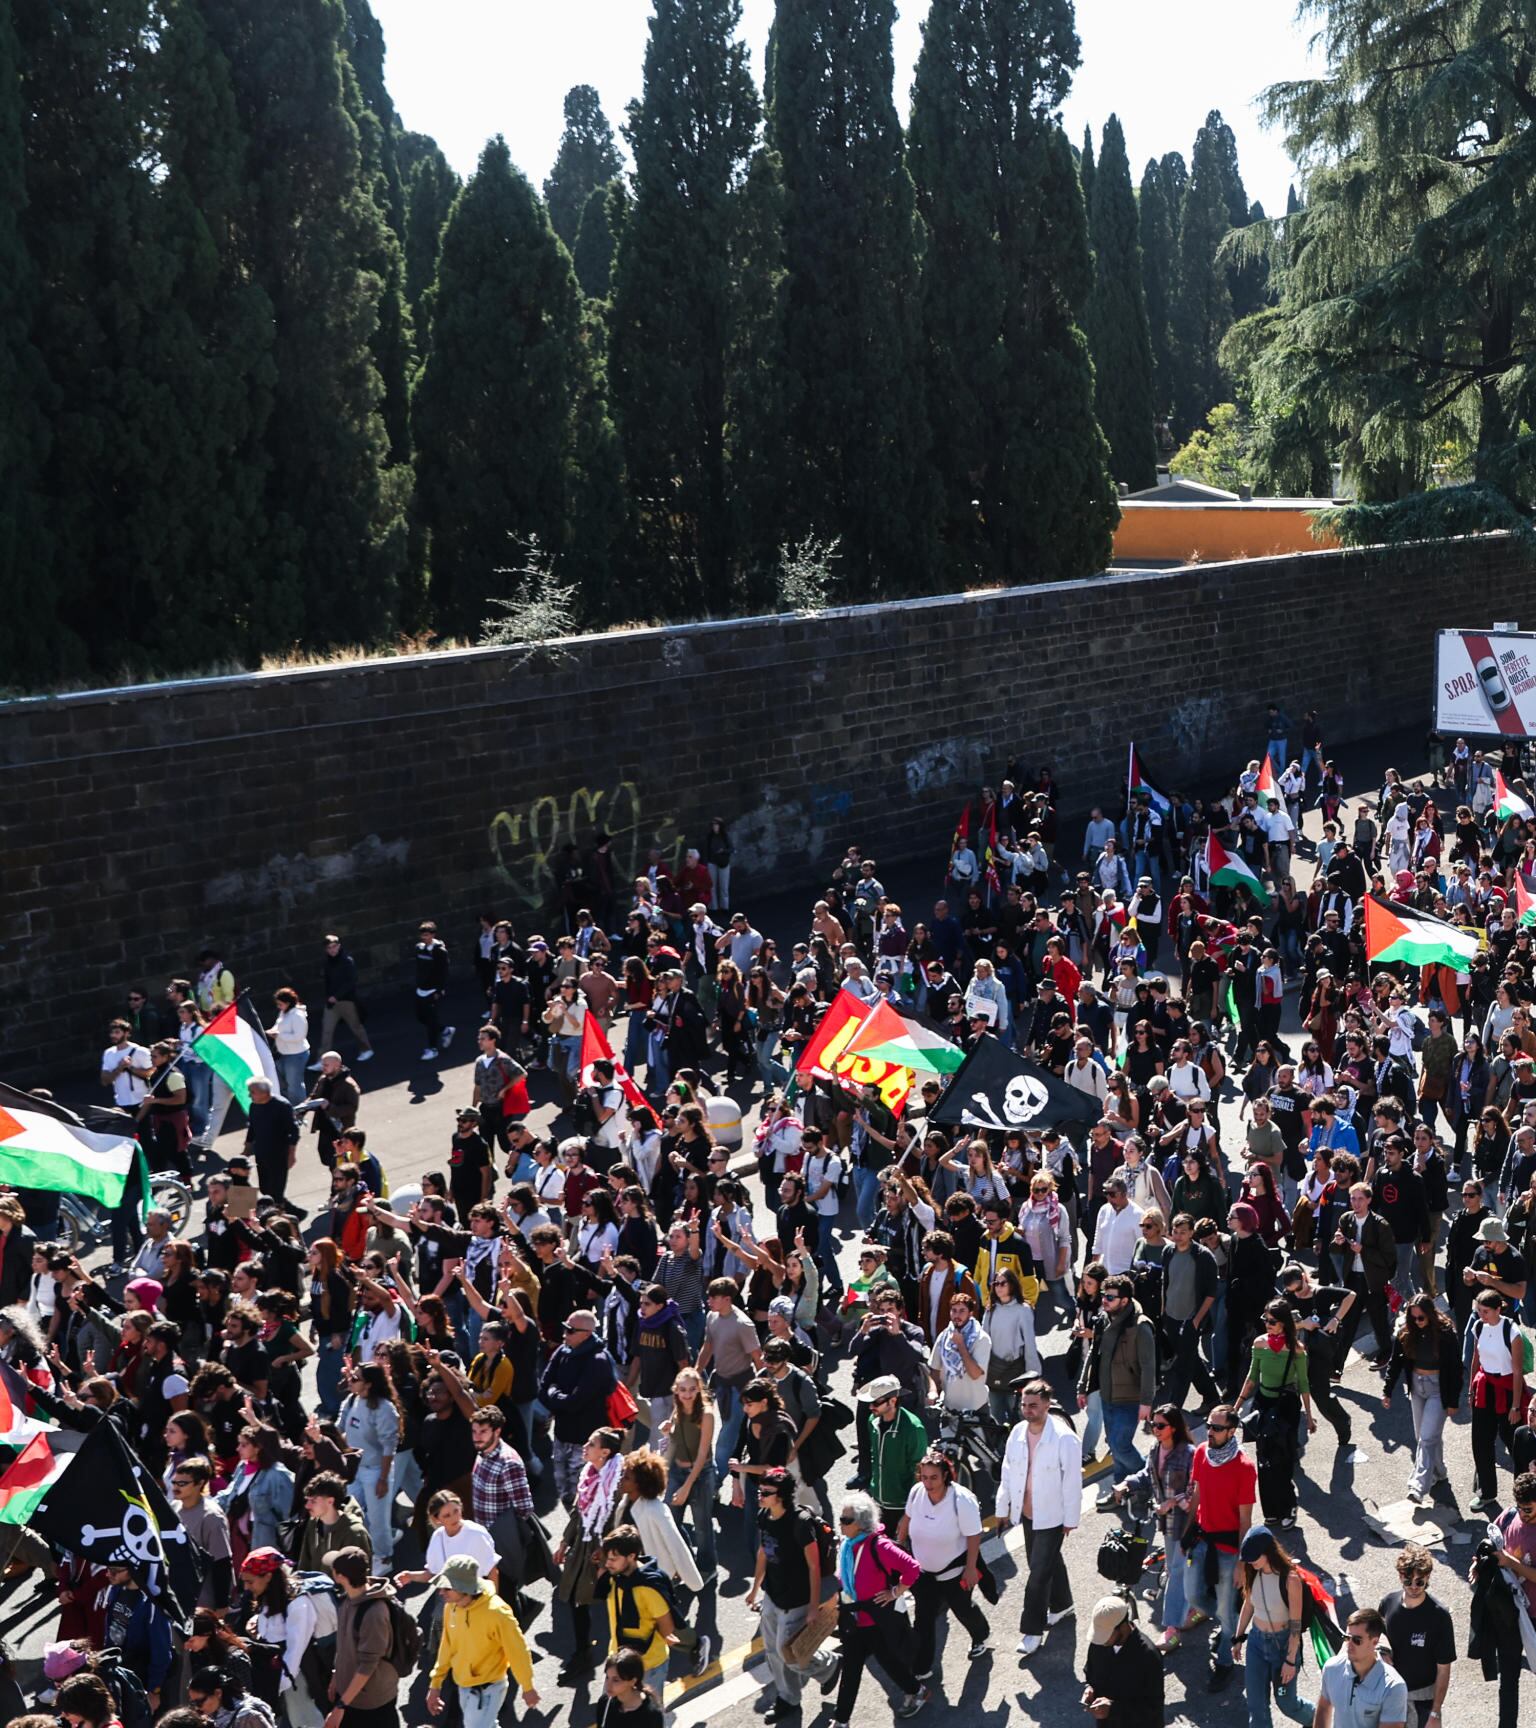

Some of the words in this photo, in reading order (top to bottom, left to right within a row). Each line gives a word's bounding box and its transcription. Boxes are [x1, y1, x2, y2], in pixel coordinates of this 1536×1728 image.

[1500, 649, 1516, 665] SONO
[1503, 655, 1531, 675] PERFETTE
[1508, 667, 1530, 685] QUESTE
[1444, 672, 1479, 700] S.P.Q.R.
